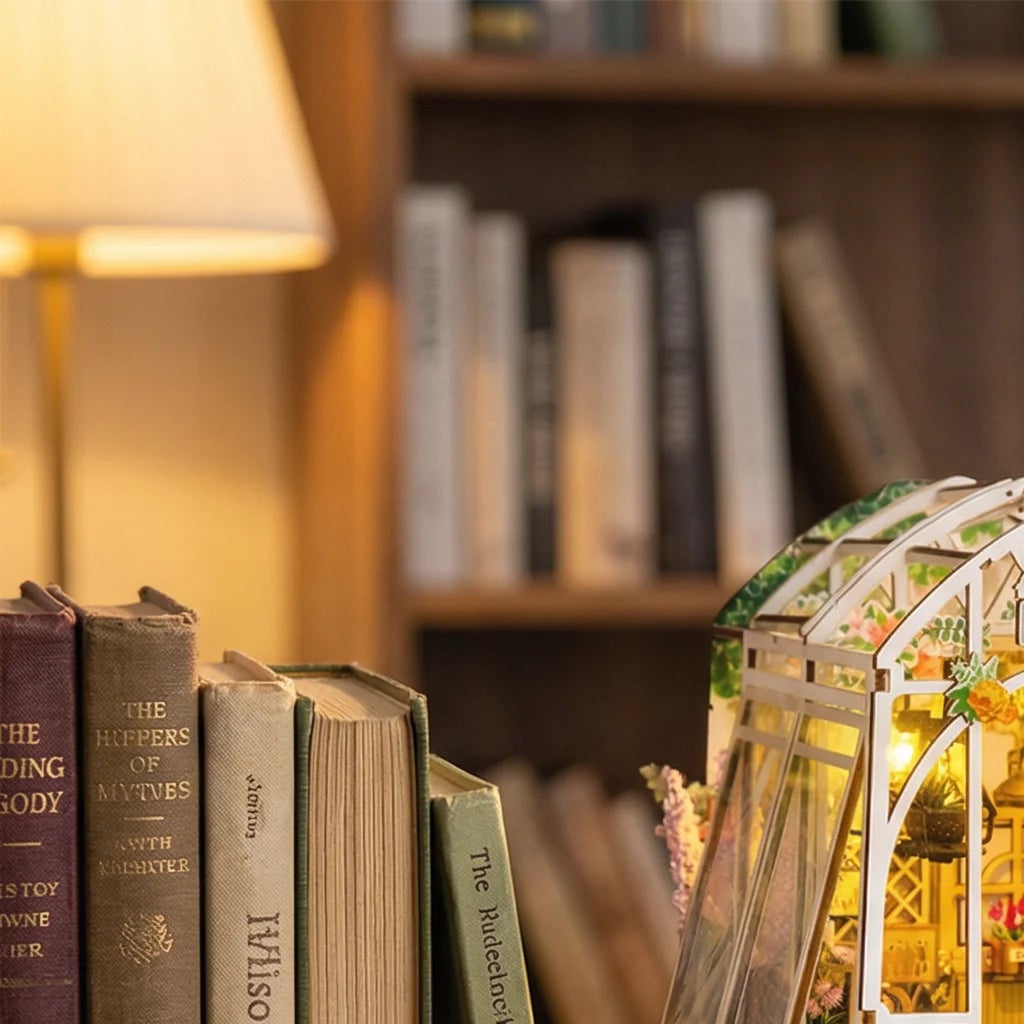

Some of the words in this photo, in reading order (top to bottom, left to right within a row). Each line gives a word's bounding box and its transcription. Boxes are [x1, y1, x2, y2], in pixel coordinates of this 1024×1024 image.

[123, 701, 167, 719] THE
[130, 755, 161, 773] OF
[470, 847, 492, 893] The
